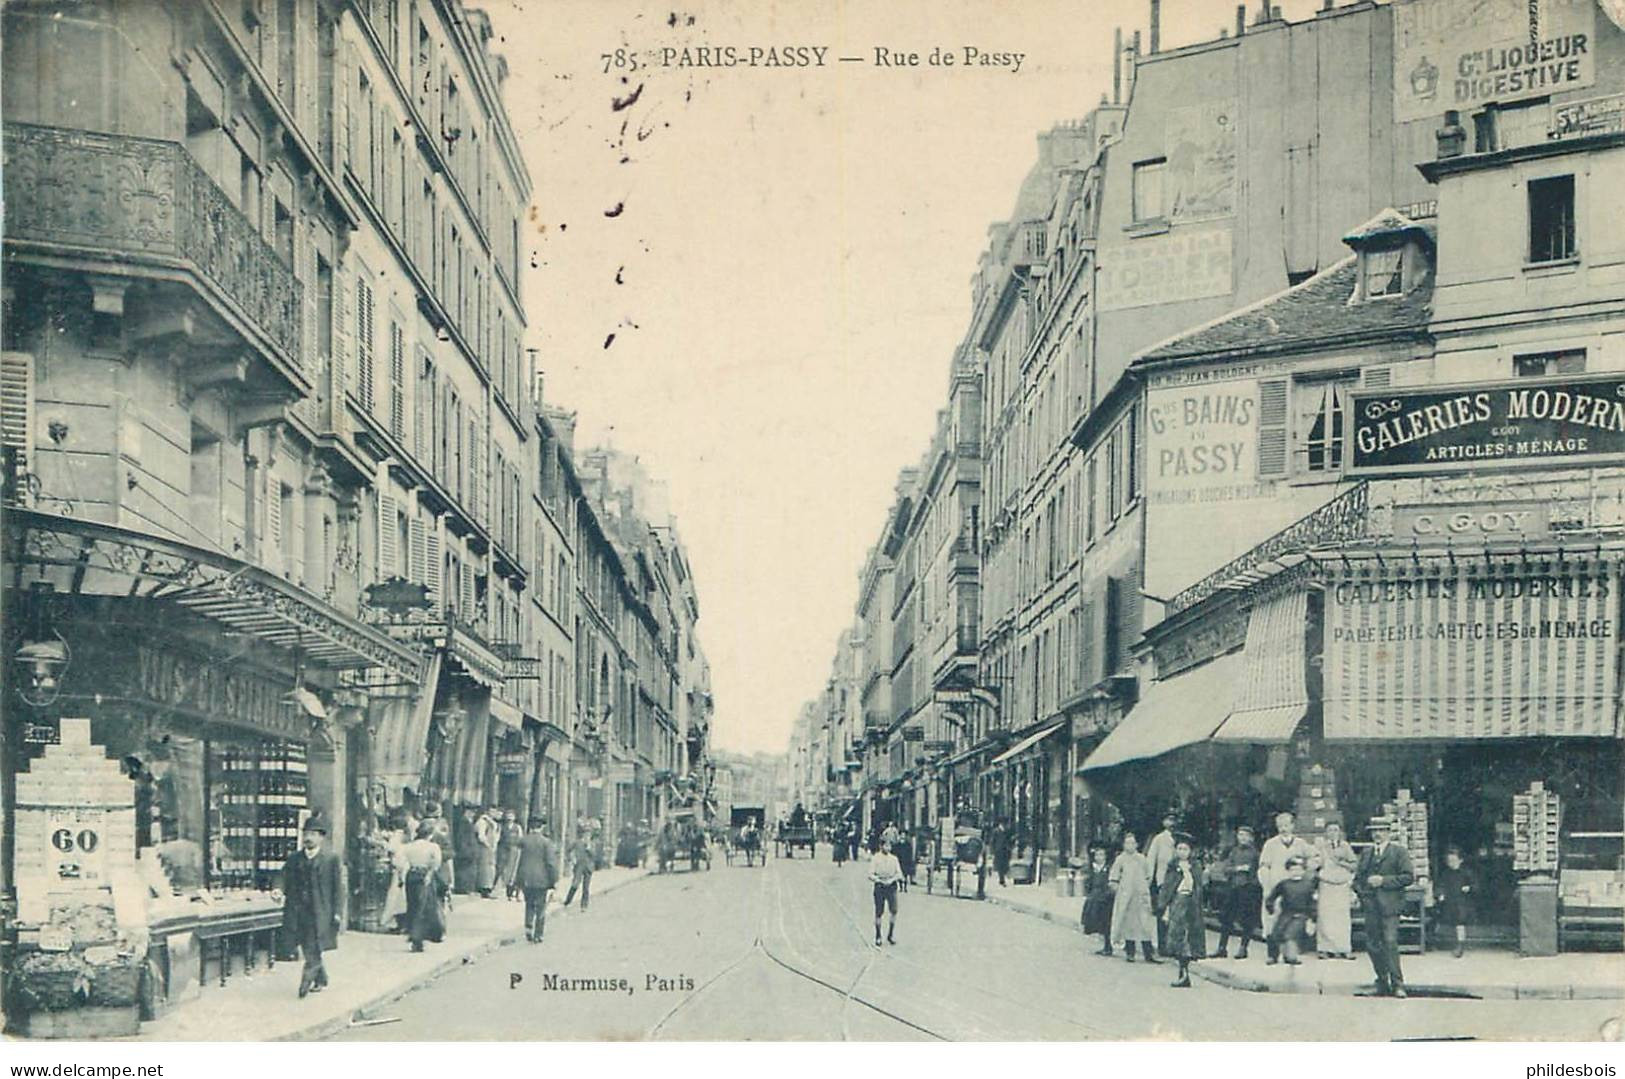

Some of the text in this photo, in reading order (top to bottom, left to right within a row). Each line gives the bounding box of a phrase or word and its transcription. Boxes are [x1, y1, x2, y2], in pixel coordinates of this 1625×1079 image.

[1454, 59, 1581, 104] DIGESTIVE
[1183, 393, 1255, 426] BAINS
[1357, 392, 1492, 454] GALERIES
[1159, 442, 1244, 477] PASSY
[1426, 442, 1504, 459] ARTICLES
[1335, 575, 1611, 606] GALERIES MODERNES
[1436, 621, 1520, 641] ARTICLES
[52, 829, 98, 853] 60
